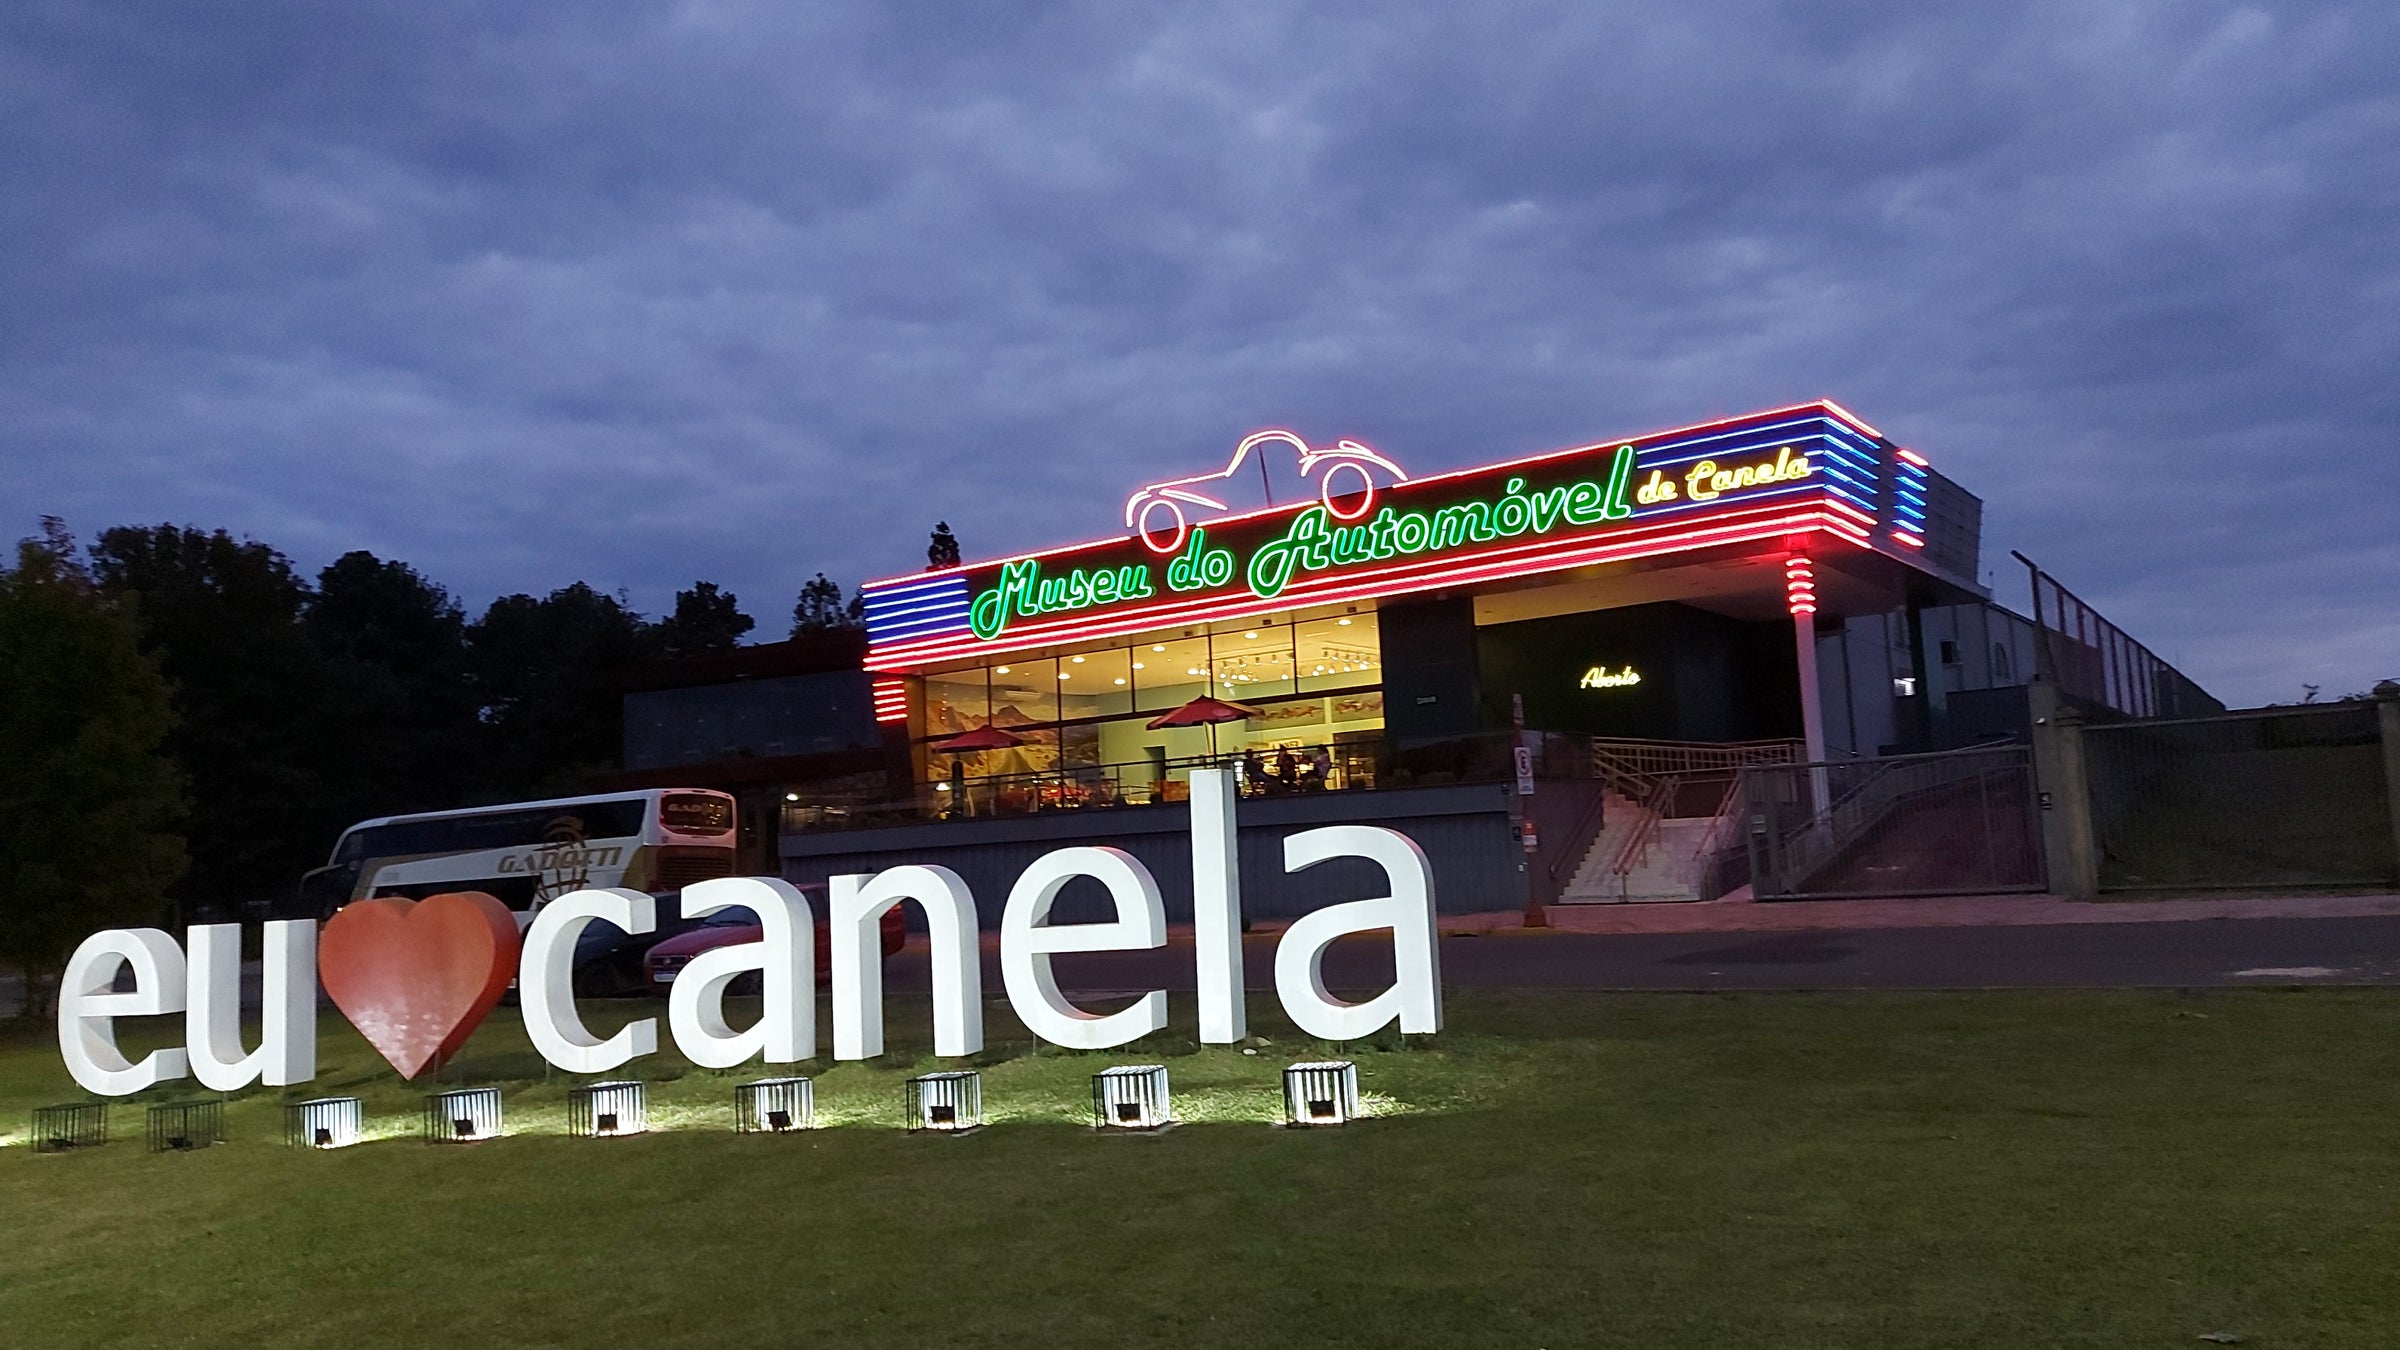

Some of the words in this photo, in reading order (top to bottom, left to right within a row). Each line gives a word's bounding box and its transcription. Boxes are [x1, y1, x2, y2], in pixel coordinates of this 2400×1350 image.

[969, 559, 1154, 640] Museu
[1167, 528, 1233, 592] do
[1247, 445, 1634, 598] Automóvel
[1637, 470, 1678, 504] de
[1685, 447, 1813, 501] Canela
[1580, 666, 1641, 689] Aberto
[58, 918, 317, 1096] eu
[519, 768, 1442, 1074] canela
